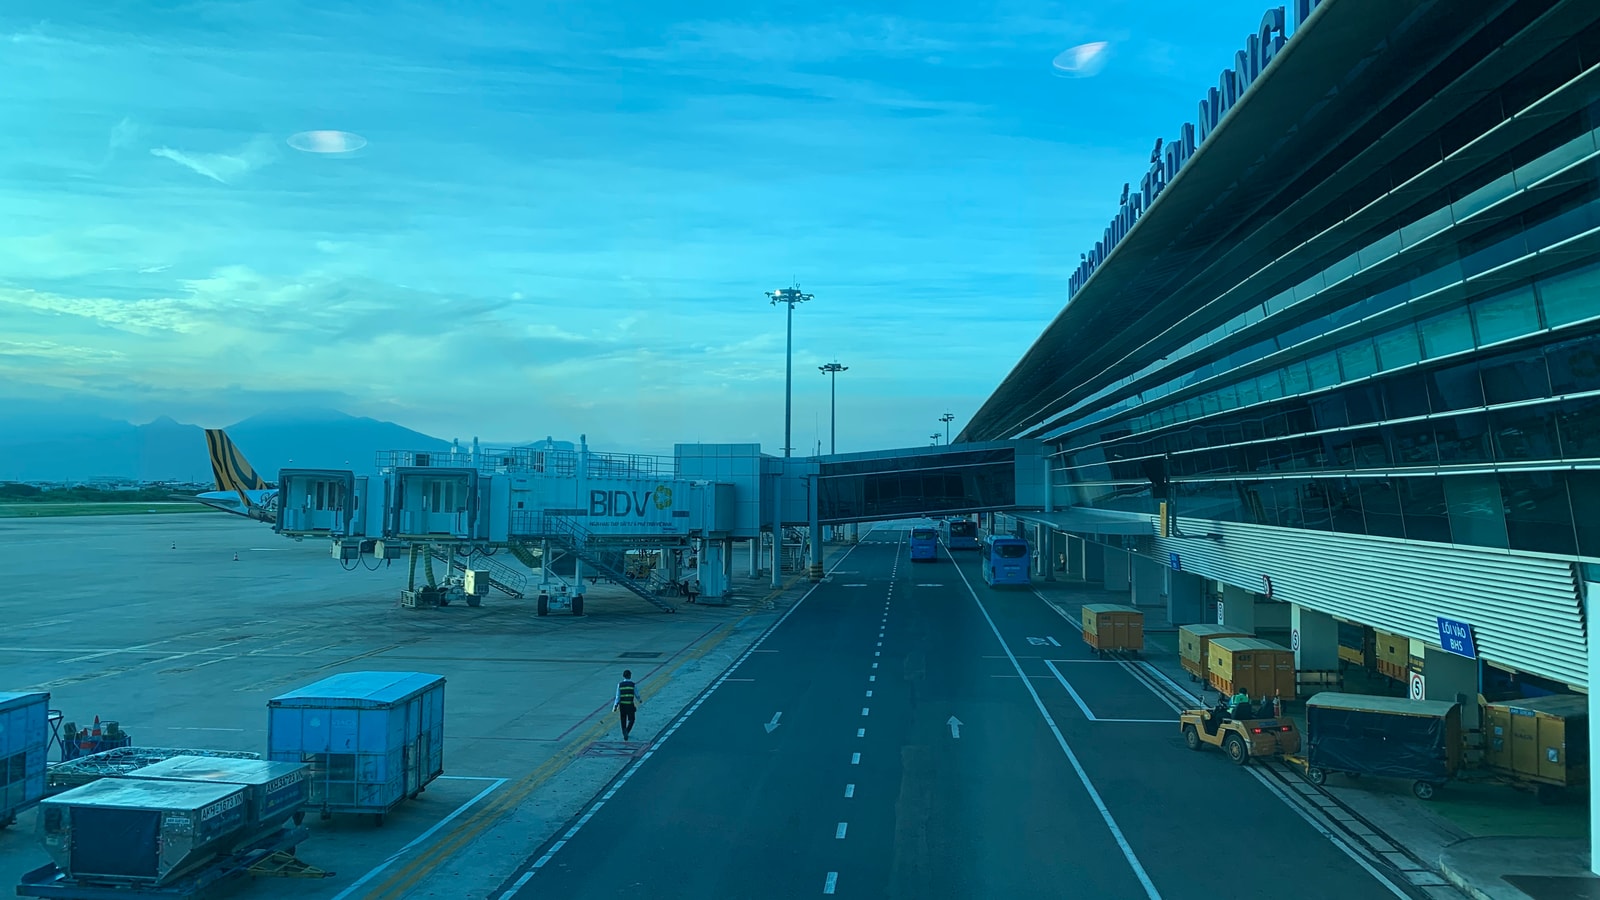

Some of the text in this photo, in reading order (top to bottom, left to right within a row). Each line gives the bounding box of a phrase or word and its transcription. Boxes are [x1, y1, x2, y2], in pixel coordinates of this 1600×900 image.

[590, 489, 653, 517] BIDV
[1449, 638, 1463, 652] BHS
[1414, 681, 1420, 697] 5
